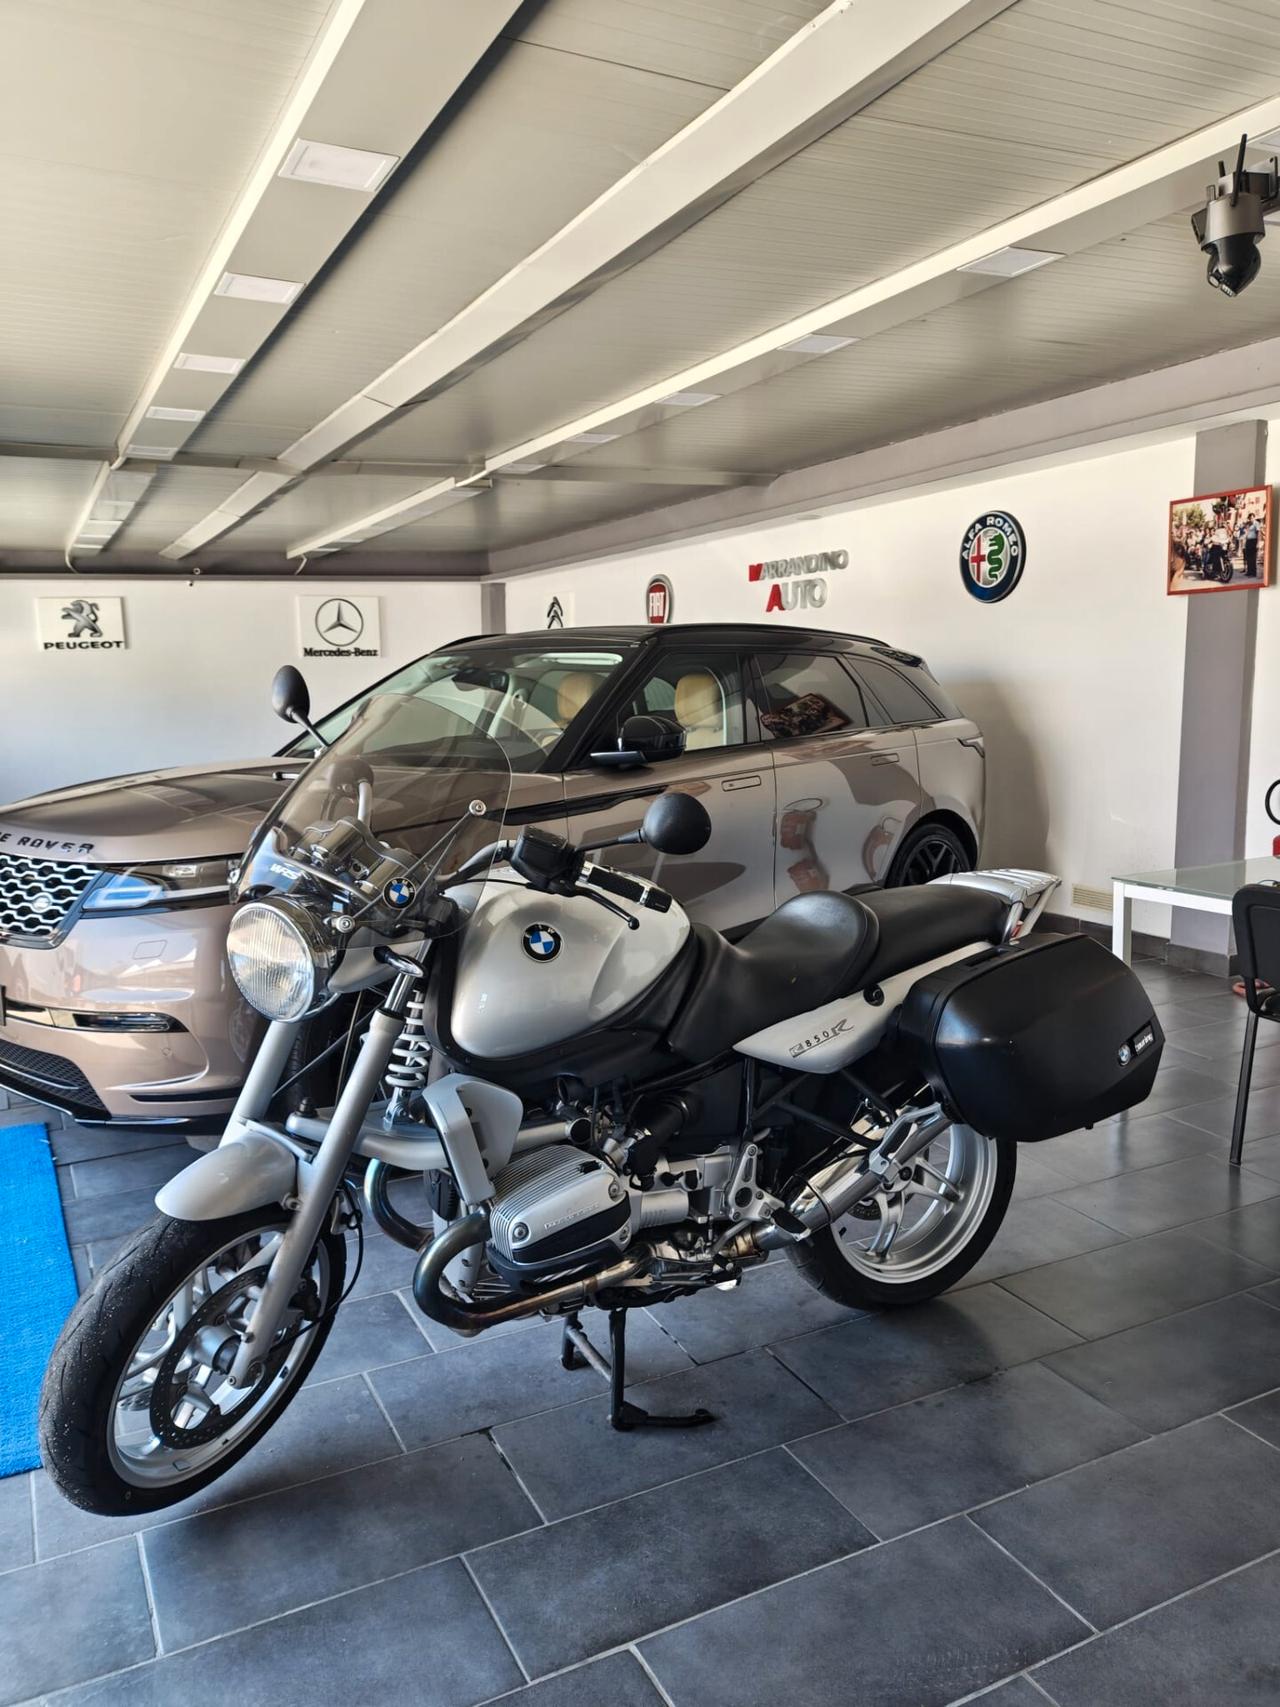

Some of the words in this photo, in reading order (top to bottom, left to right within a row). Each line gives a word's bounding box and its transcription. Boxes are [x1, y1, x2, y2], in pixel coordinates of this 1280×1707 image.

[961, 522, 983, 560] ALFA
[985, 515, 1019, 557] ROMEO
[766, 577, 827, 612] AUTO
[43, 640, 124, 650] PEUGEOT
[303, 647, 378, 657] Mercedes-Benz
[17, 836, 95, 854] ROVER
